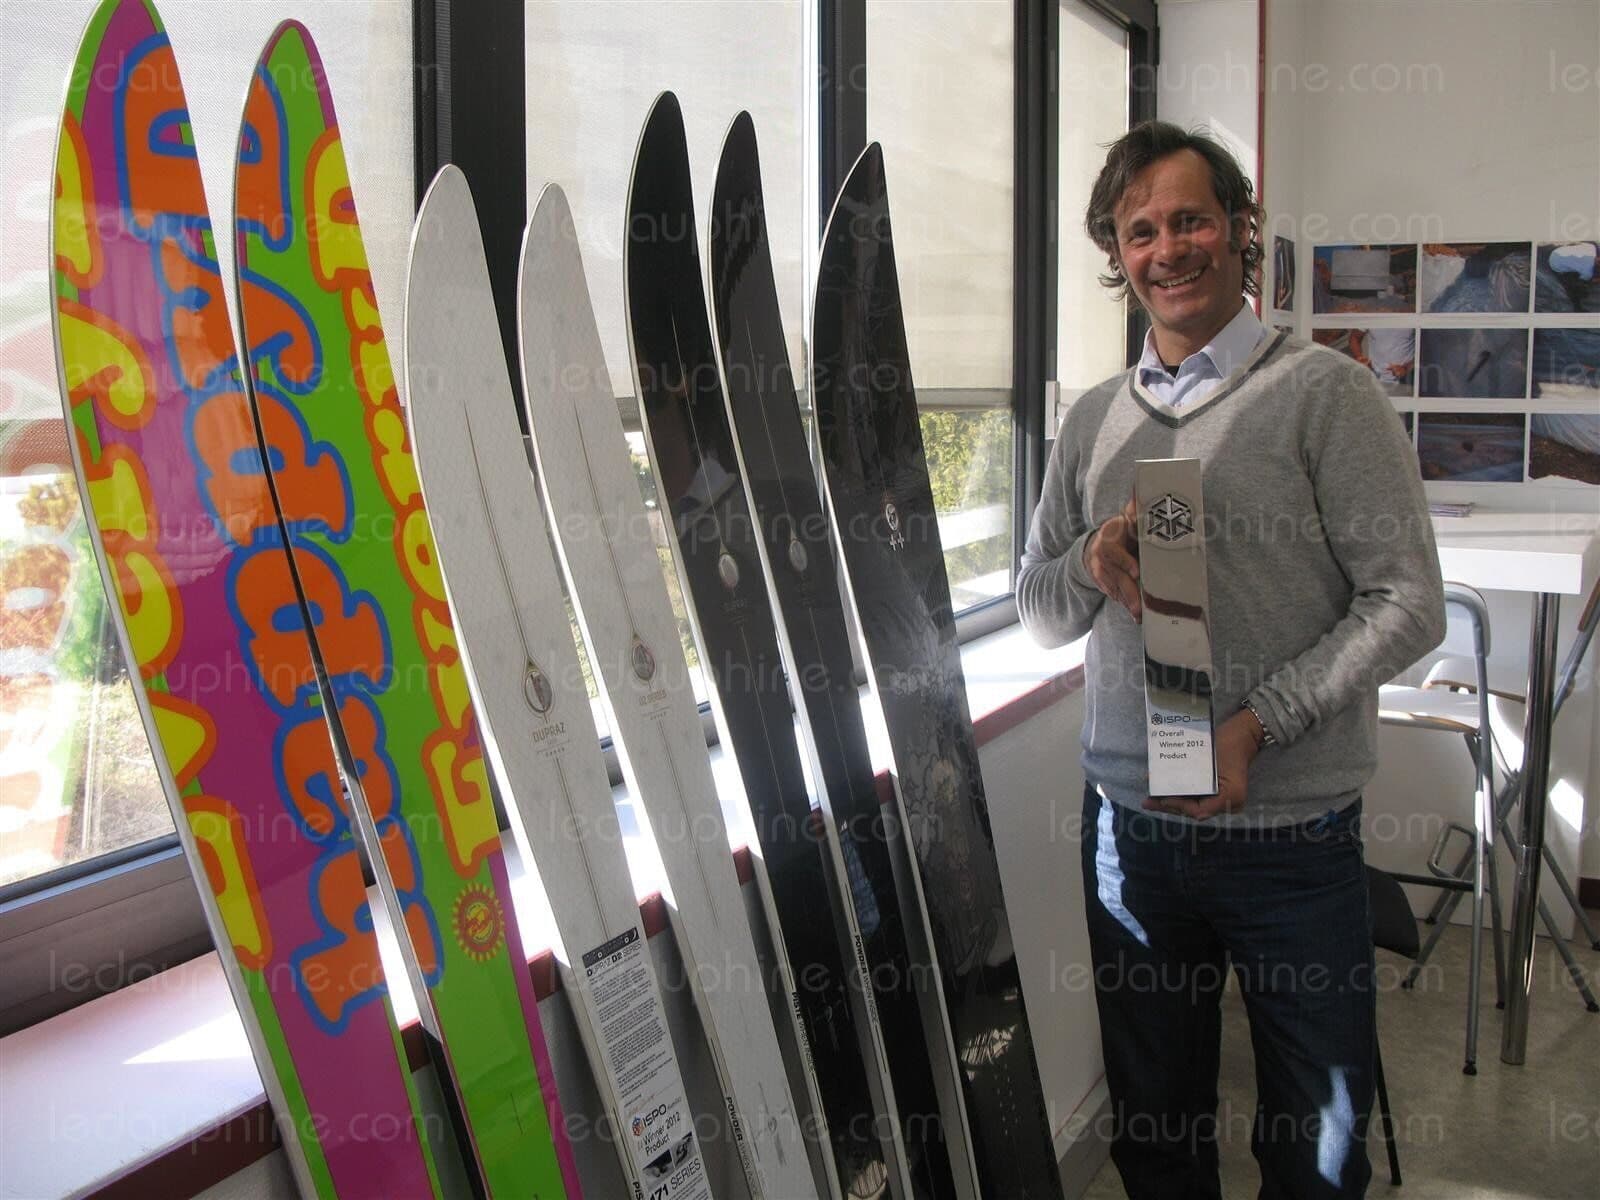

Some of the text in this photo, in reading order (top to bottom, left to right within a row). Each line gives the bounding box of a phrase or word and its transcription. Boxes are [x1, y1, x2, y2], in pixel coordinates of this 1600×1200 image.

[1163, 715, 1191, 724] ISPO
[532, 722, 566, 743] DUPRAZ
[1186, 740, 1204, 748] 2012
[1159, 752, 1187, 760] Product
[855, 935, 867, 974] POWDER
[642, 1104, 667, 1128] ISPO
[726, 1096, 743, 1141] POWDER
[643, 1111, 681, 1146] Winner 2012
[645, 1133, 670, 1156] Product
[670, 1158, 701, 1190] SERIES
